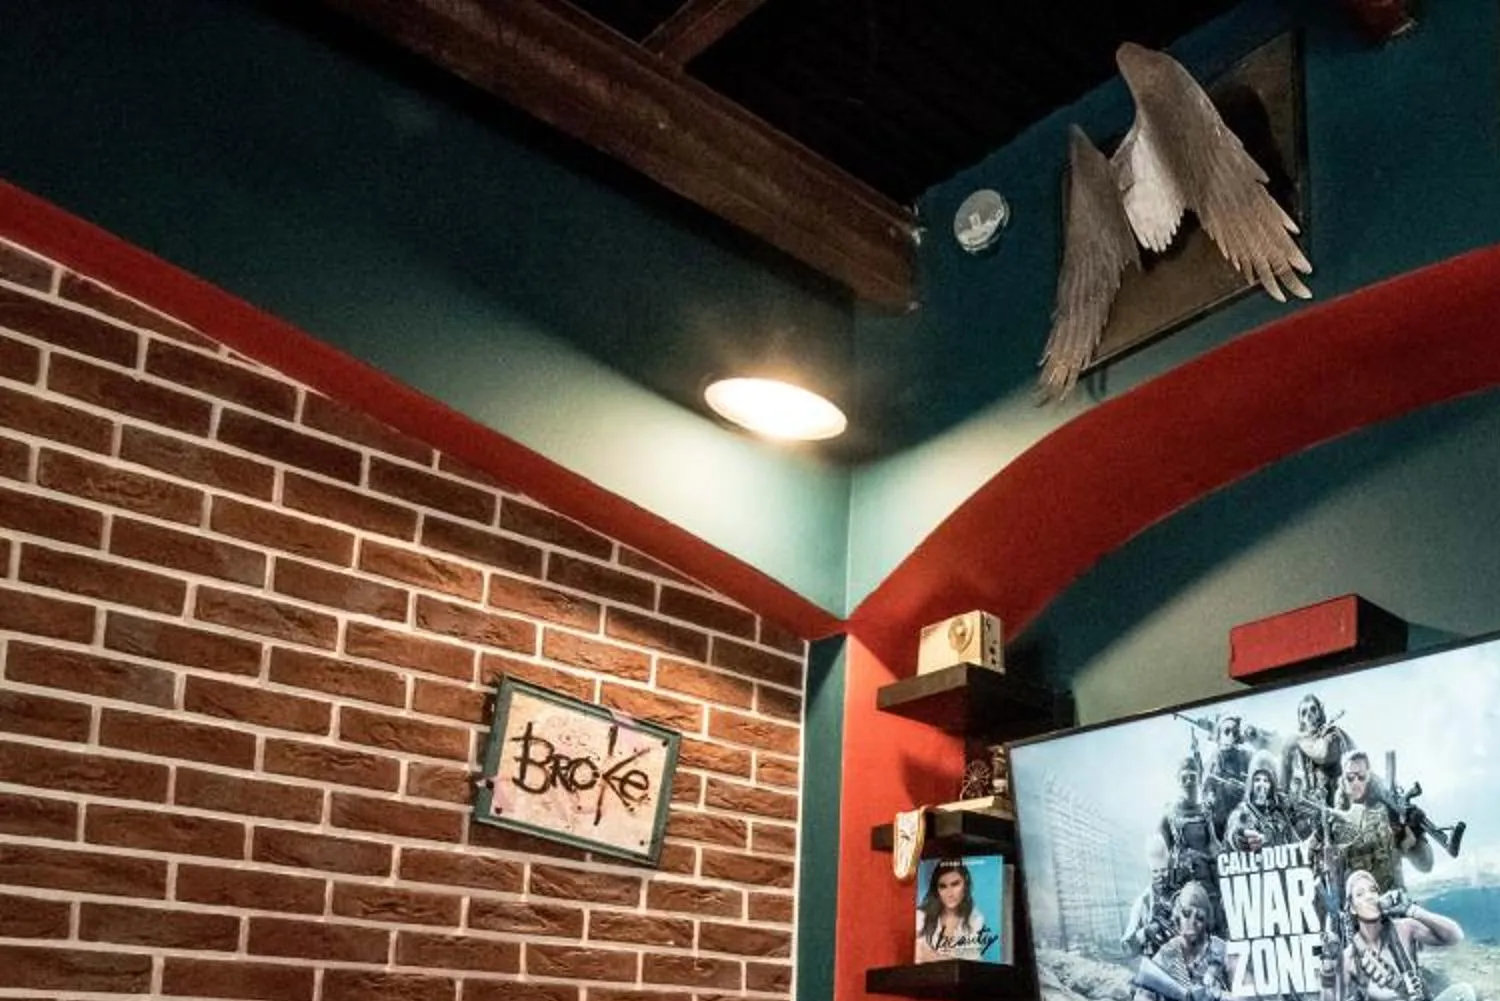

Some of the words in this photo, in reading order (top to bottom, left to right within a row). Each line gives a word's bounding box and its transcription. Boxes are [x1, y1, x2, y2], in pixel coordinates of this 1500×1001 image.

[1217, 851, 1259, 876] CALL
[1262, 844, 1312, 868] DUTY
[1219, 868, 1321, 940] WAR
[1226, 935, 1323, 997] ZONE
